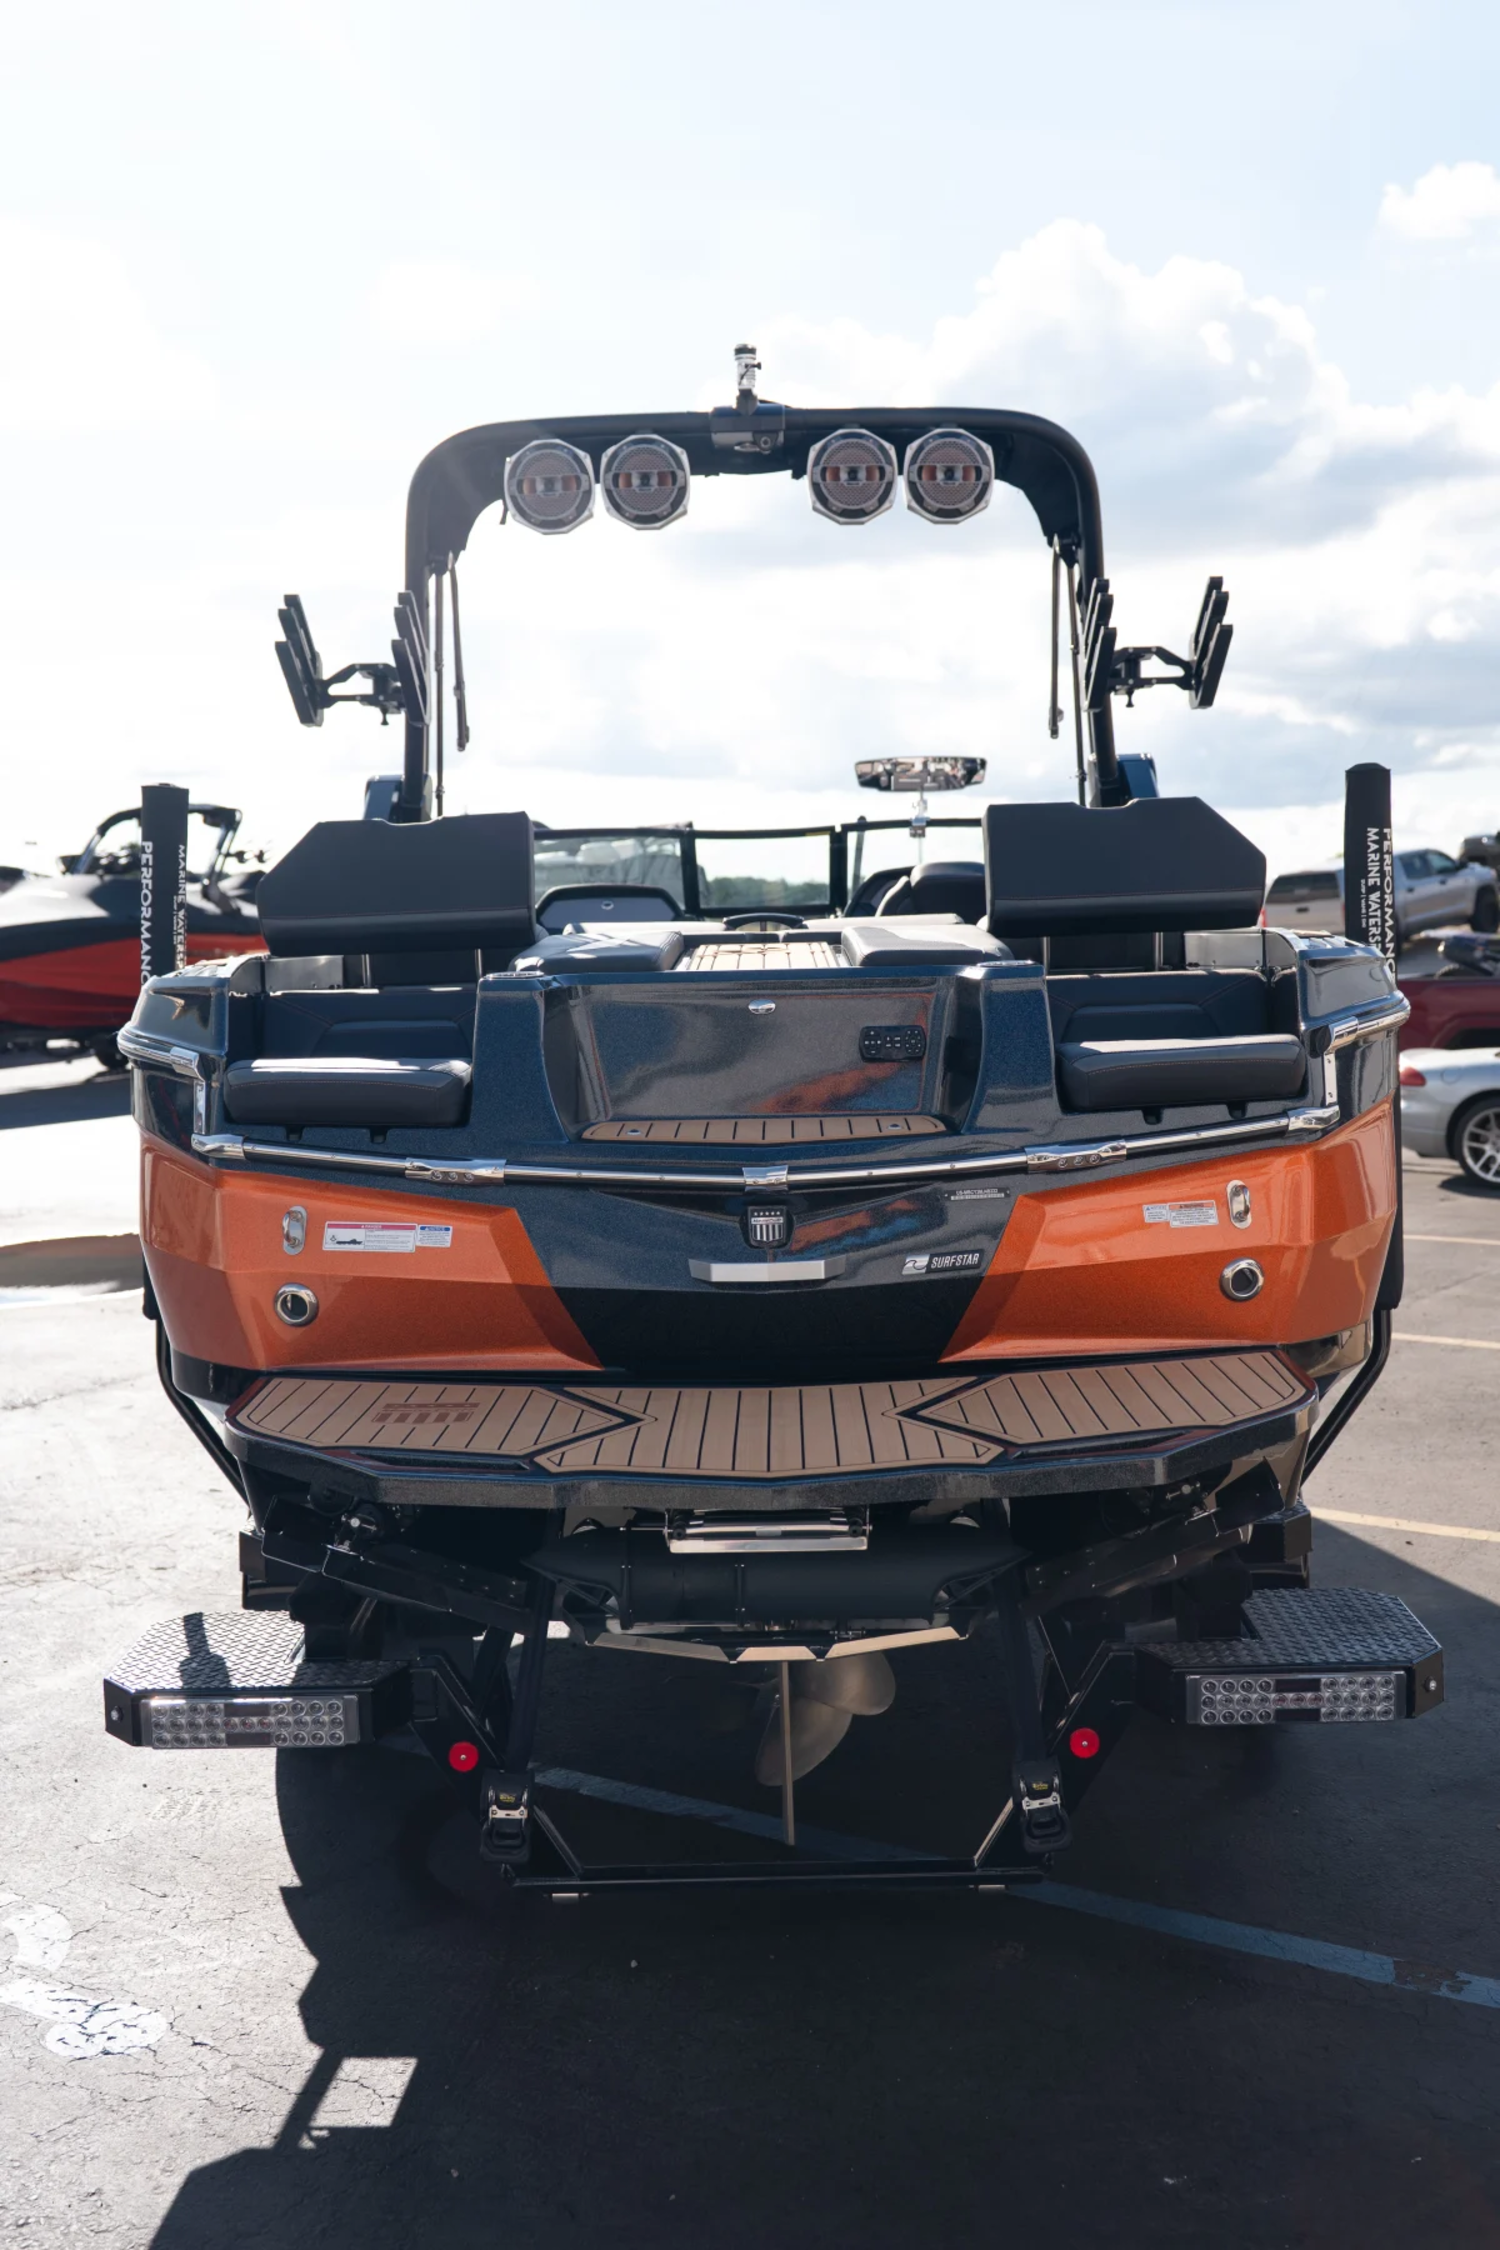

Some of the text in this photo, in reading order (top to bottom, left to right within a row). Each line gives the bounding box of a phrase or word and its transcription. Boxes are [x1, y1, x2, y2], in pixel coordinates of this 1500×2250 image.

[177, 844, 186, 903] MARINE
[1367, 827, 1381, 886] MARINE
[931, 1253, 980, 1269] SURFSTAR
